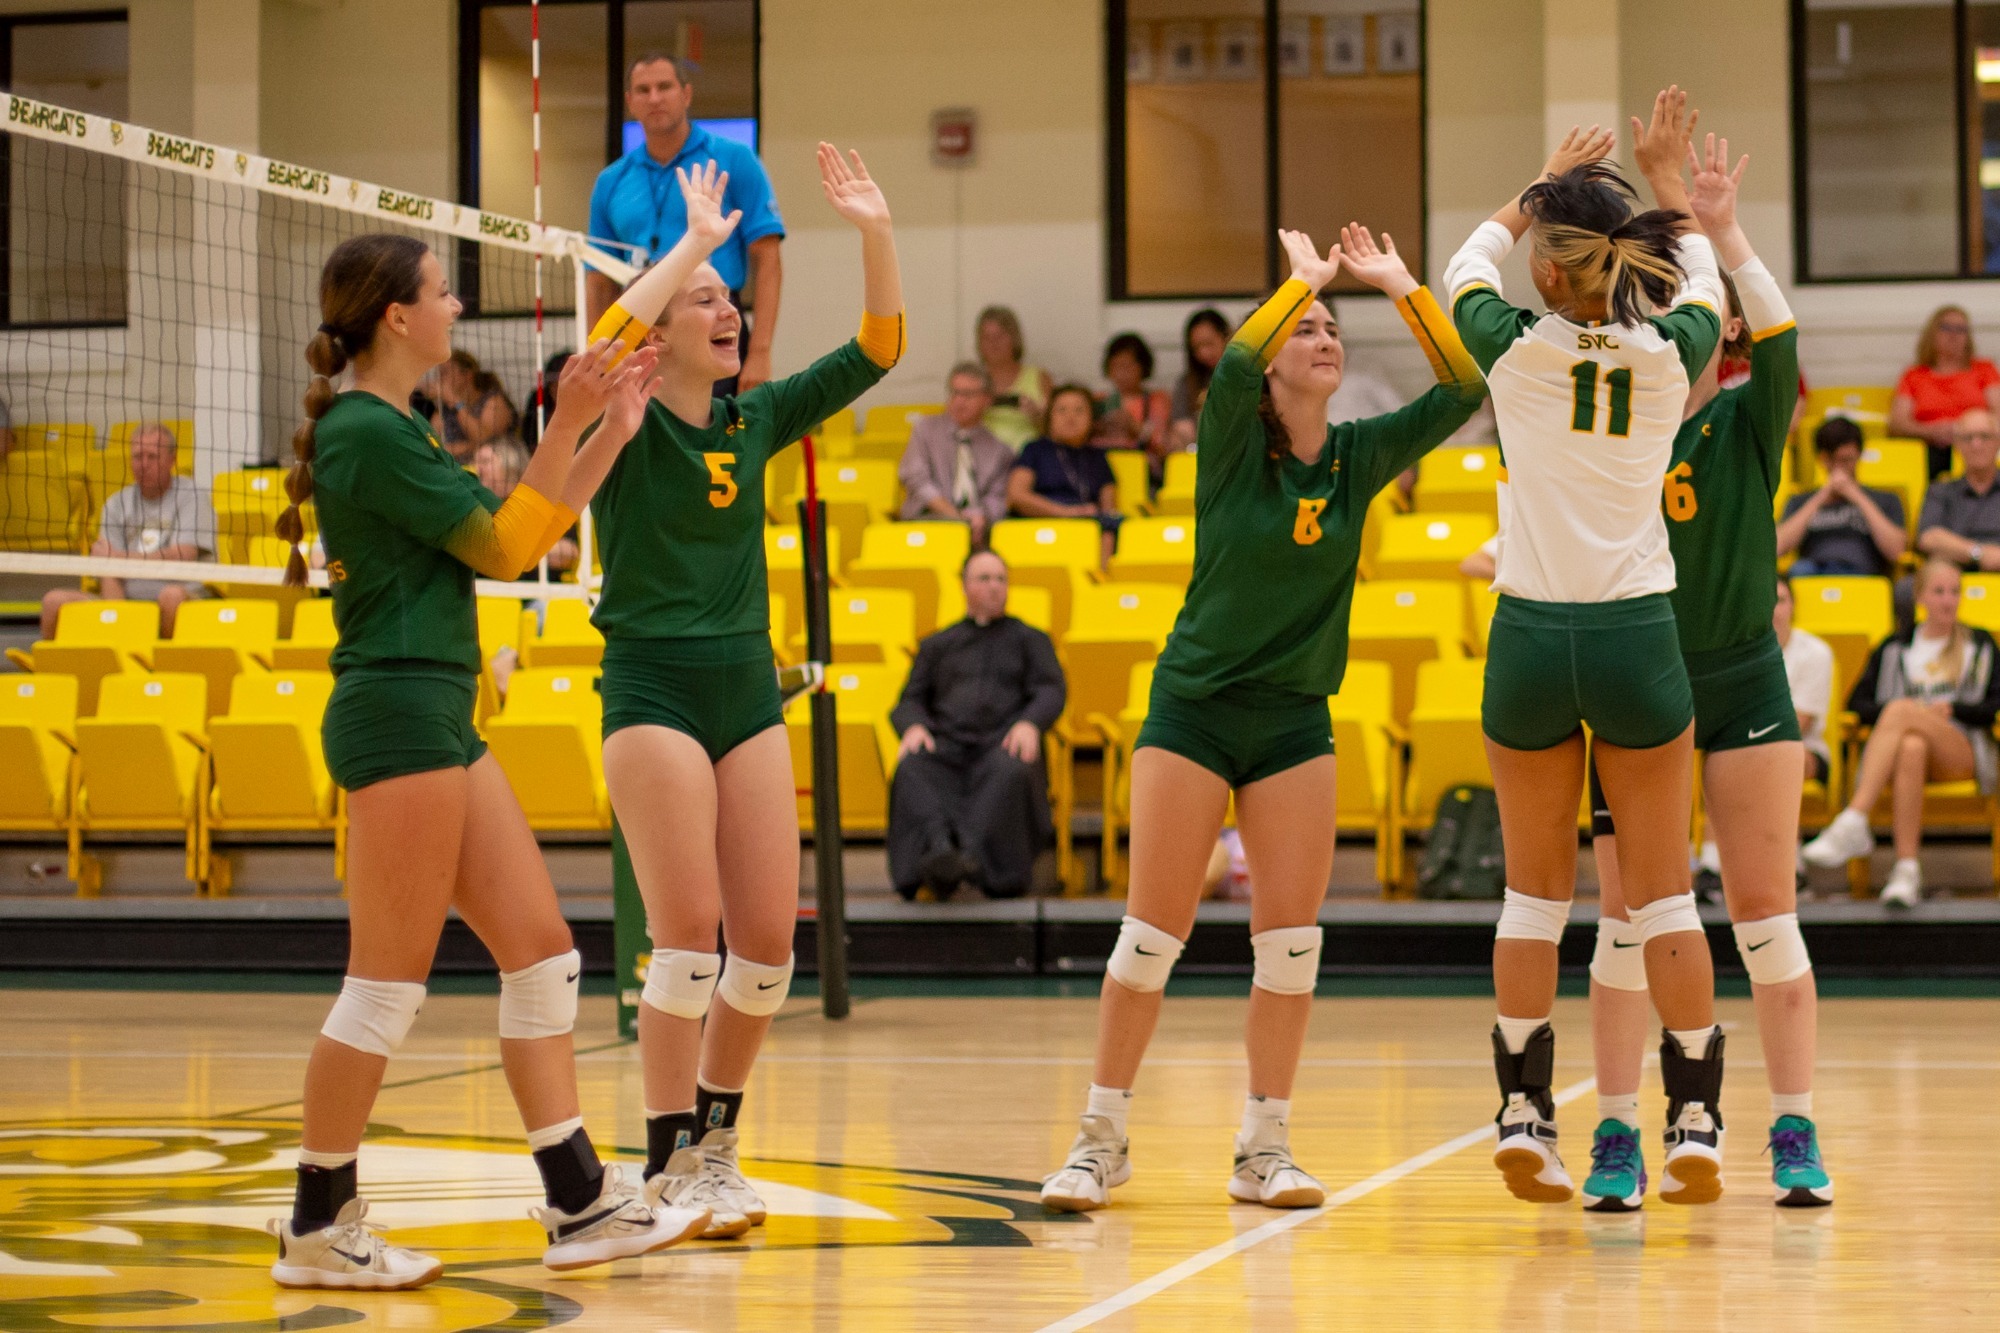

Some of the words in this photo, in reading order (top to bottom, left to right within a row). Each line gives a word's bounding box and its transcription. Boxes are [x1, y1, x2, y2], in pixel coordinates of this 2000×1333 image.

[9, 96, 86, 138] BEARCATS
[147, 132, 214, 169] BEARCATS
[267, 161, 329, 195] BEARCATS
[377, 189, 433, 220] BEARCATS
[479, 212, 529, 242] BEARCATS
[1577, 333, 1619, 350] SVC
[1568, 359, 1633, 439] 11
[703, 452, 738, 508] 5
[1292, 498, 1327, 545] 8
